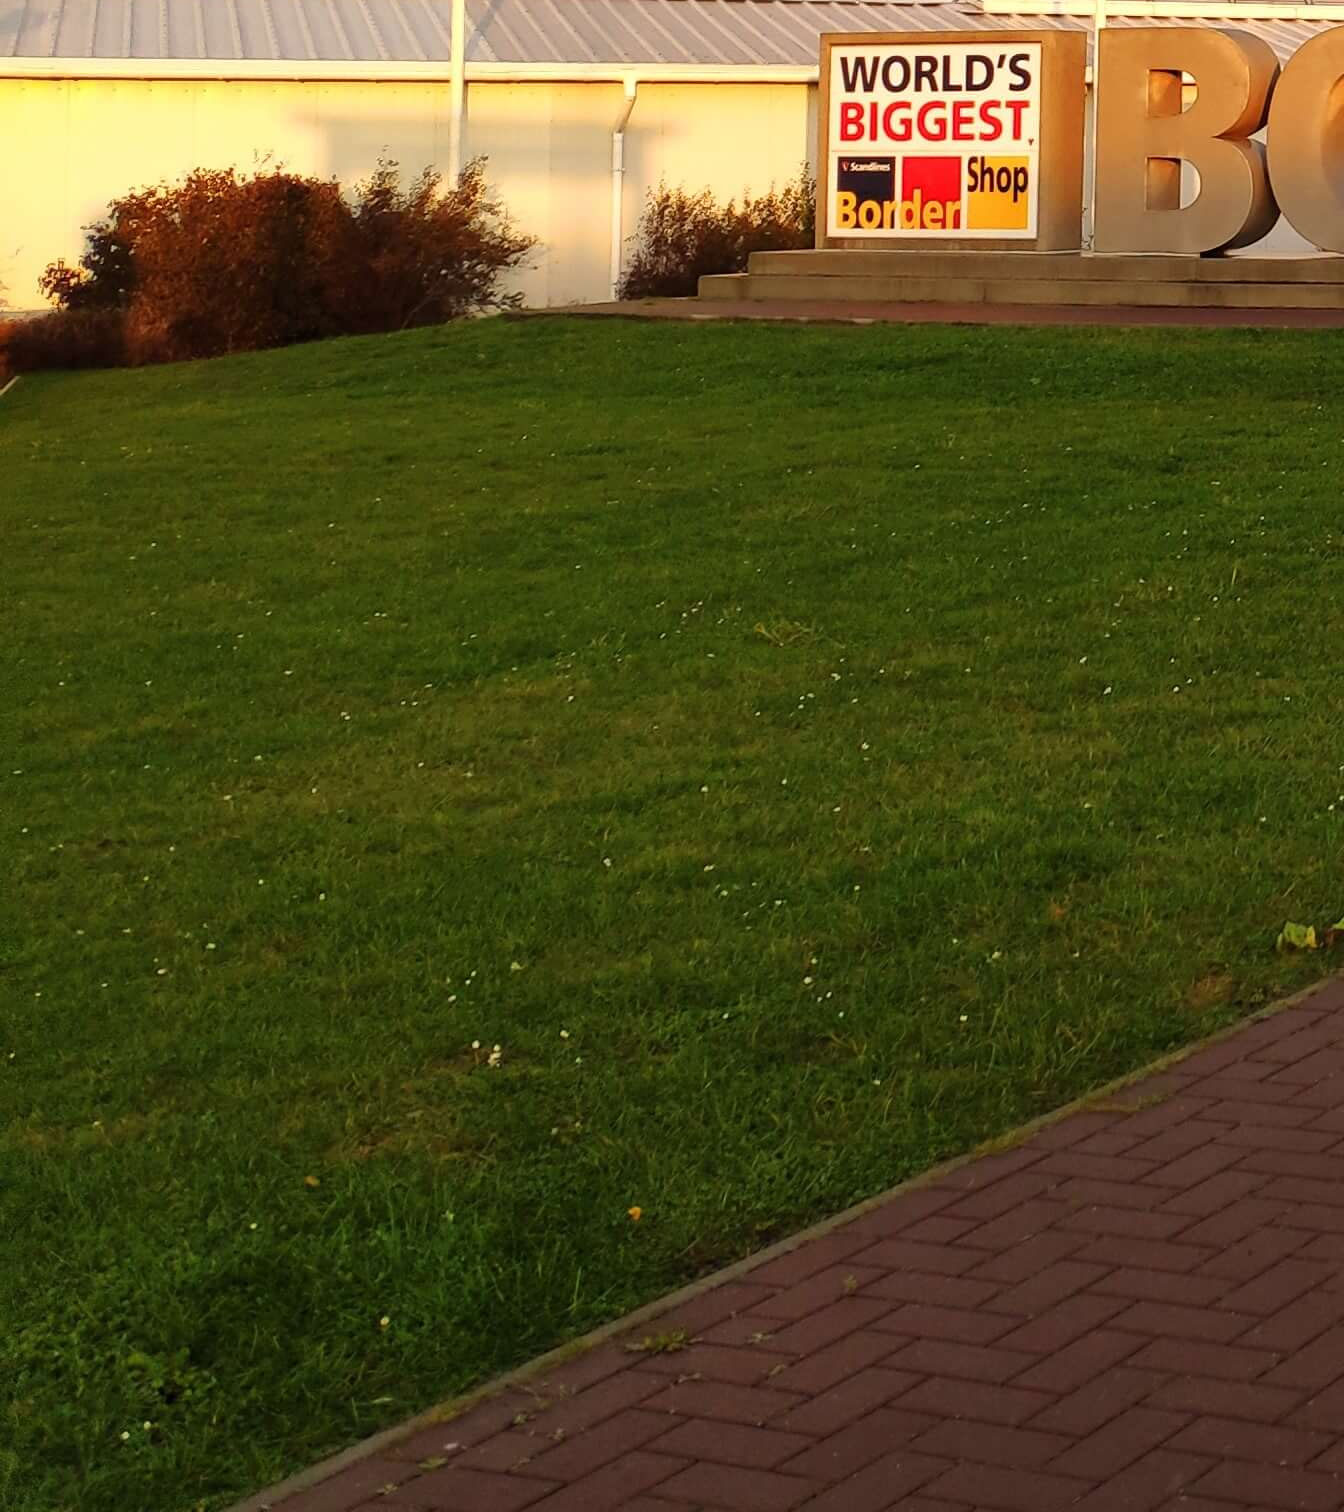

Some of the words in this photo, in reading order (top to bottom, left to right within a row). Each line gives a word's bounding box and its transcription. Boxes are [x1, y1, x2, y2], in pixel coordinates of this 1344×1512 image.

[840, 53, 1031, 94] WORLD'S
[839, 99, 1031, 142] BIGGEST
[850, 162, 890, 173] Scandlines
[967, 156, 1029, 203] Shop
[836, 188, 961, 230] Border
